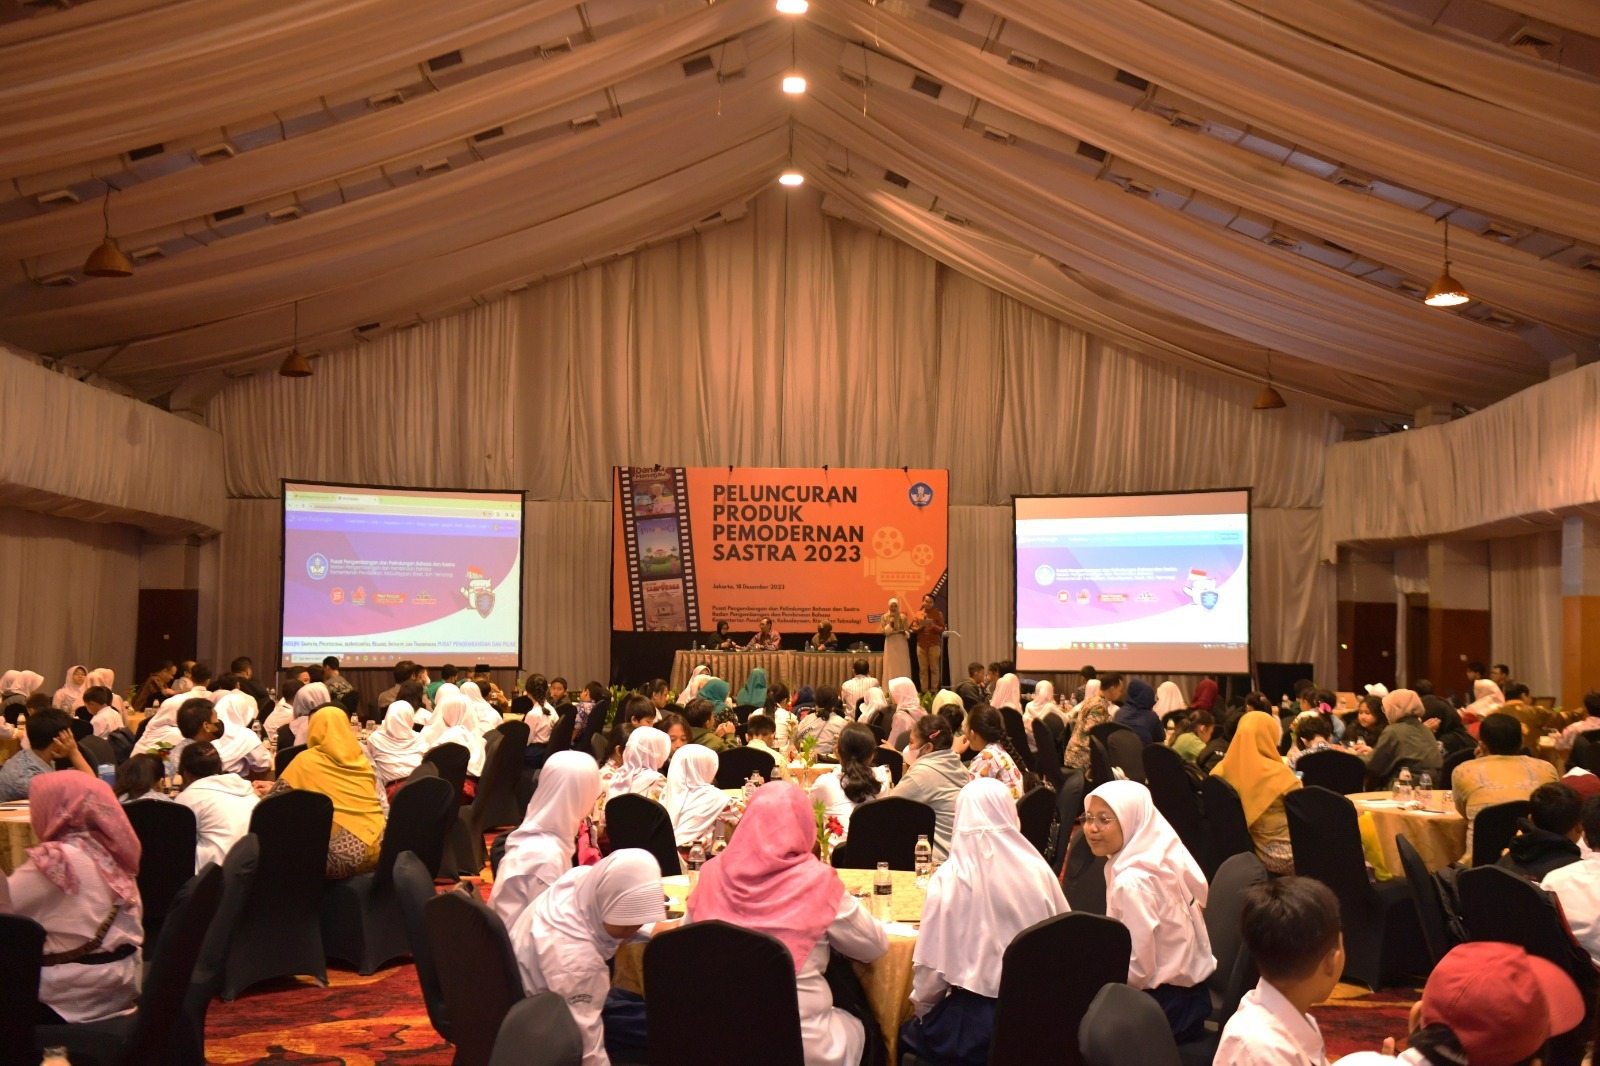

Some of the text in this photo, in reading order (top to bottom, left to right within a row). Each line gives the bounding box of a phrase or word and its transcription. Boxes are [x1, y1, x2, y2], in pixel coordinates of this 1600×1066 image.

[636, 467, 665, 475] Danu
[713, 484, 857, 503] PELUNCURAN
[713, 504, 803, 522] PRODUK
[712, 524, 864, 542] PEMODERNAN
[712, 544, 861, 562] SASTRA 2023
